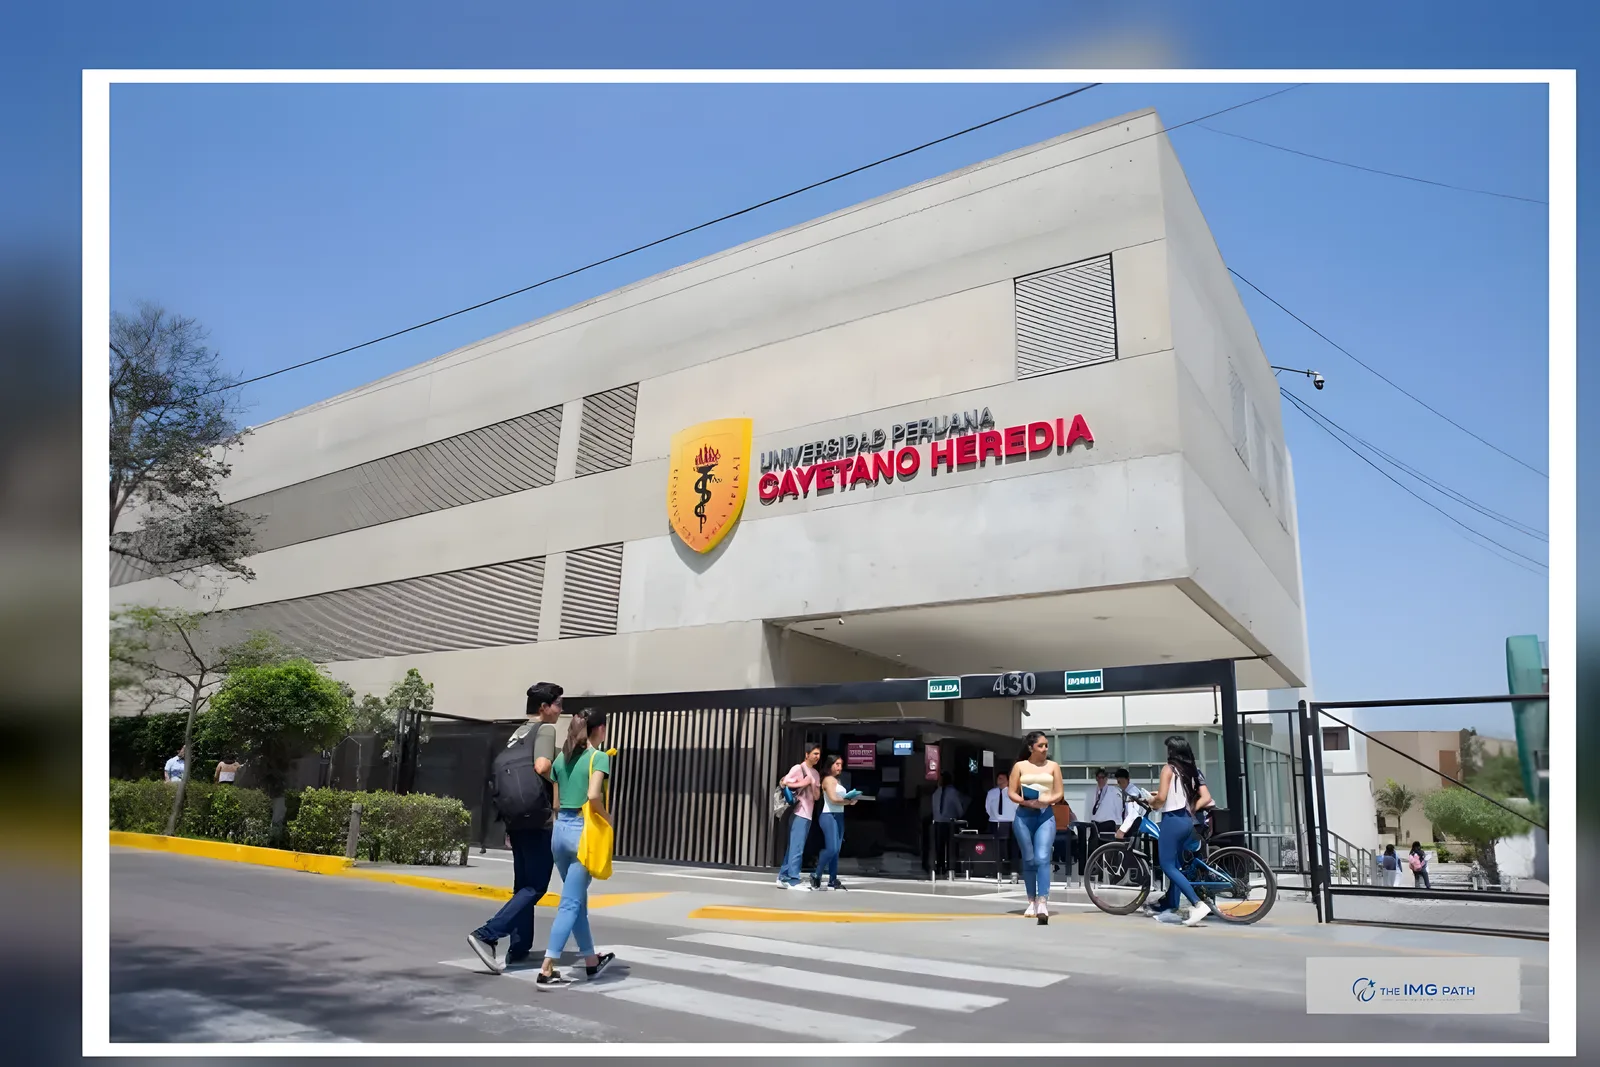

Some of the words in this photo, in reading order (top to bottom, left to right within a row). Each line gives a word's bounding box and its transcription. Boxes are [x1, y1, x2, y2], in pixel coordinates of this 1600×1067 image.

[892, 407, 994, 444] PERUANA
[759, 446, 920, 500] CAYETANO
[931, 414, 1094, 469] HEREDIA
[993, 672, 1036, 695] 430
